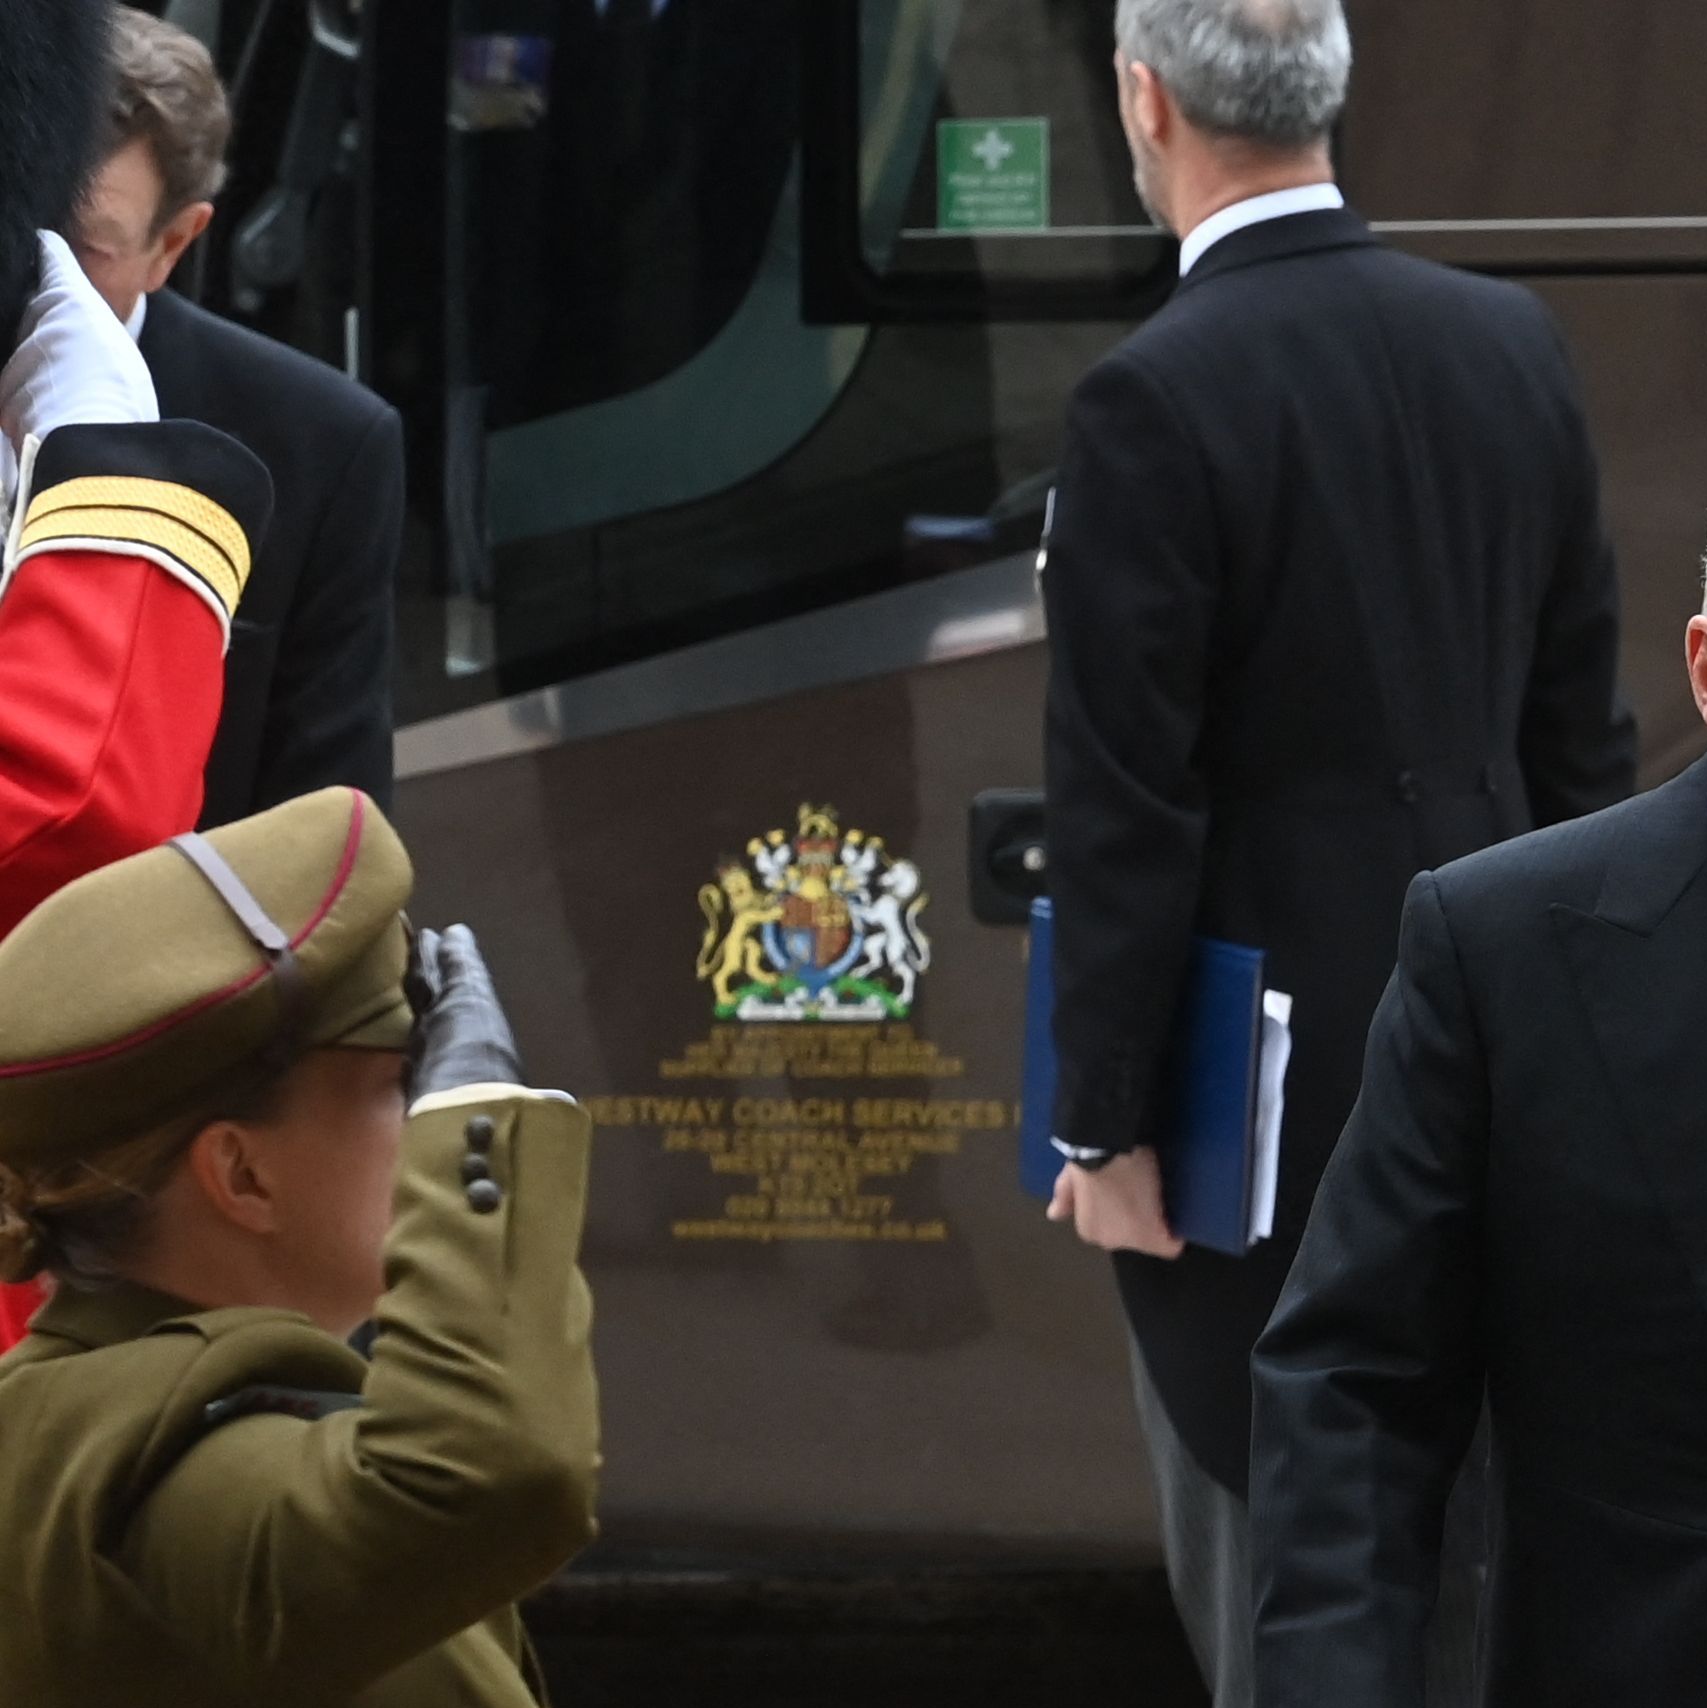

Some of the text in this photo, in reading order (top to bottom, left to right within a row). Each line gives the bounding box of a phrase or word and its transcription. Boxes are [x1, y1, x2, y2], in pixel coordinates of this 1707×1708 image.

[584, 1097, 725, 1126] ESTWAY
[731, 1097, 845, 1127] COACH
[852, 1098, 1006, 1128] SERVICES
